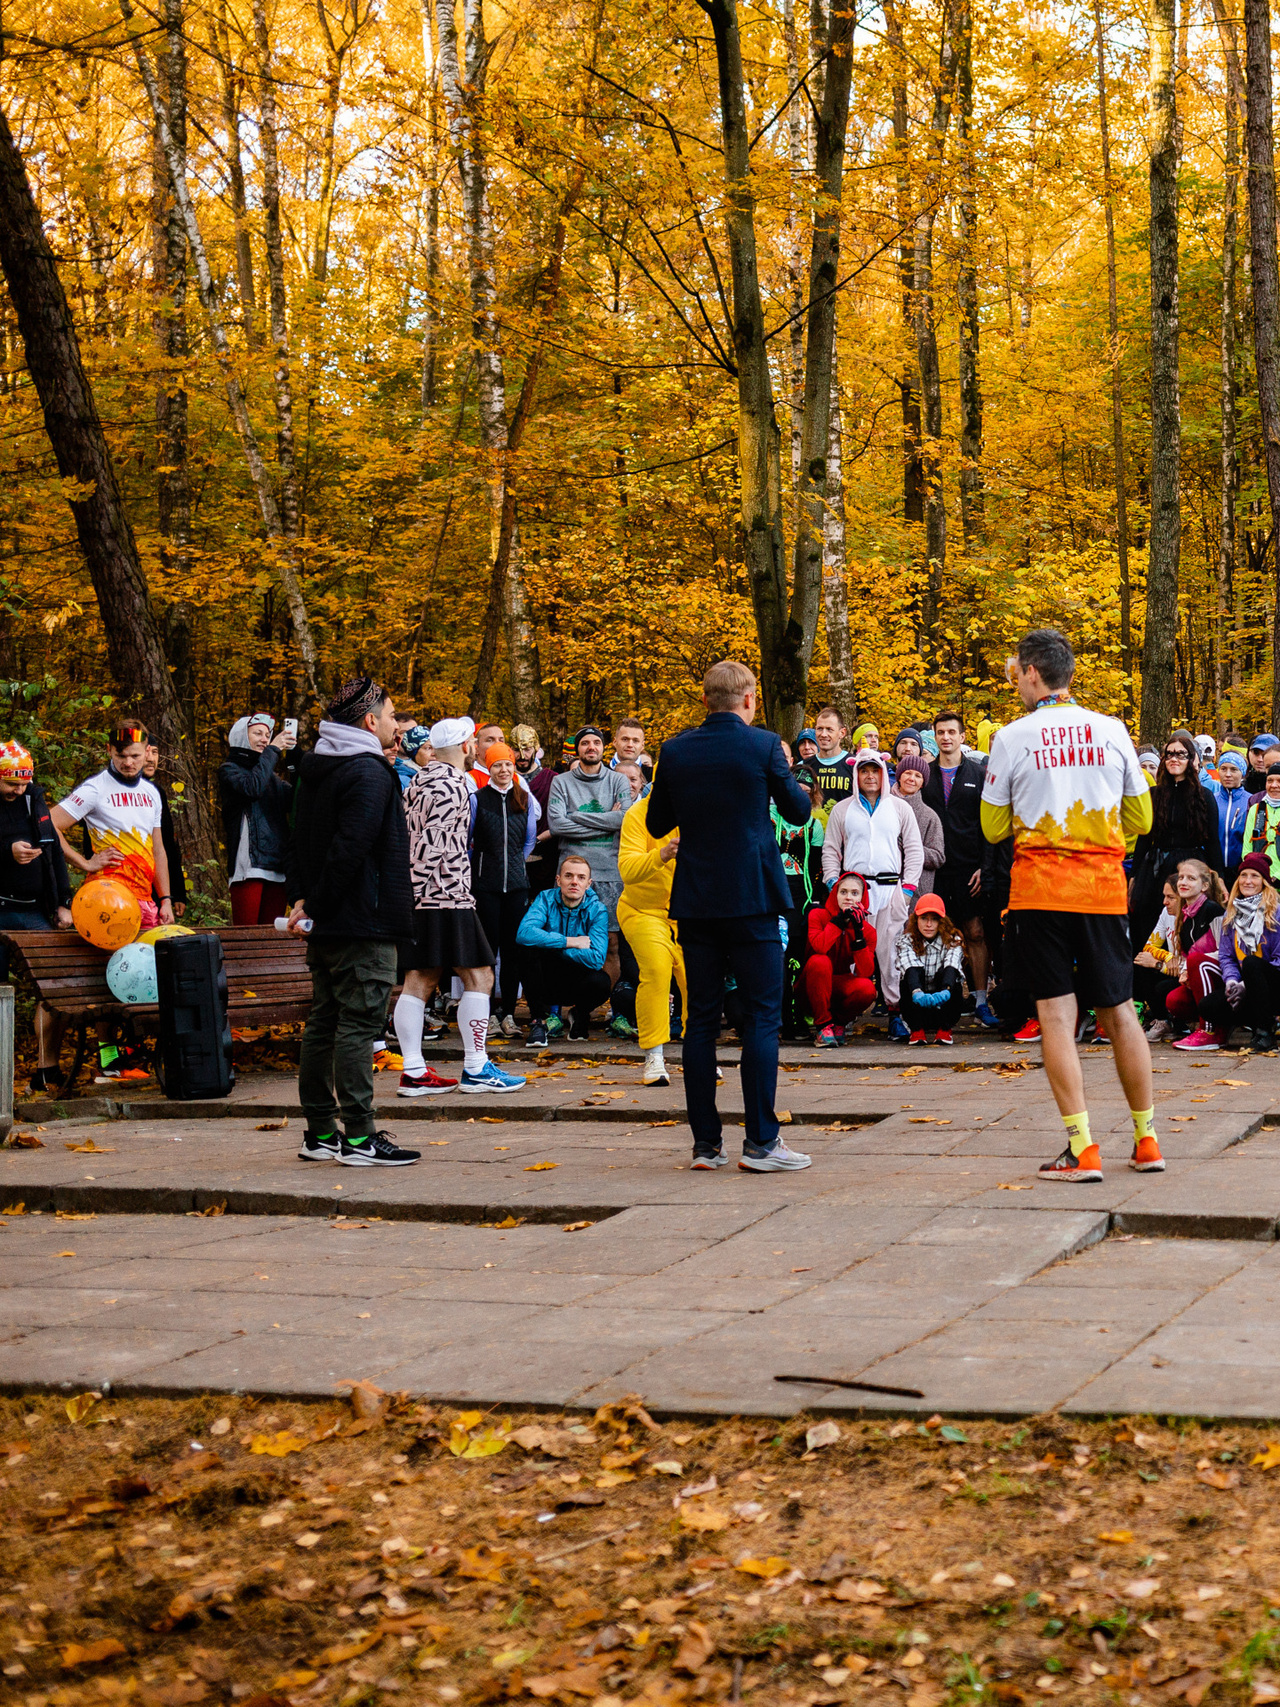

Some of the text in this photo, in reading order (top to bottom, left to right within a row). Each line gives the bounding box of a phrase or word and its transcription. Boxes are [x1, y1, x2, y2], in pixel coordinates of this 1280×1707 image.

[1041, 723, 1093, 746] СЕРГЕЙ
[1033, 745, 1105, 770] ТЕБАЙКИН
[110, 793, 153, 808] IZMYLONG
